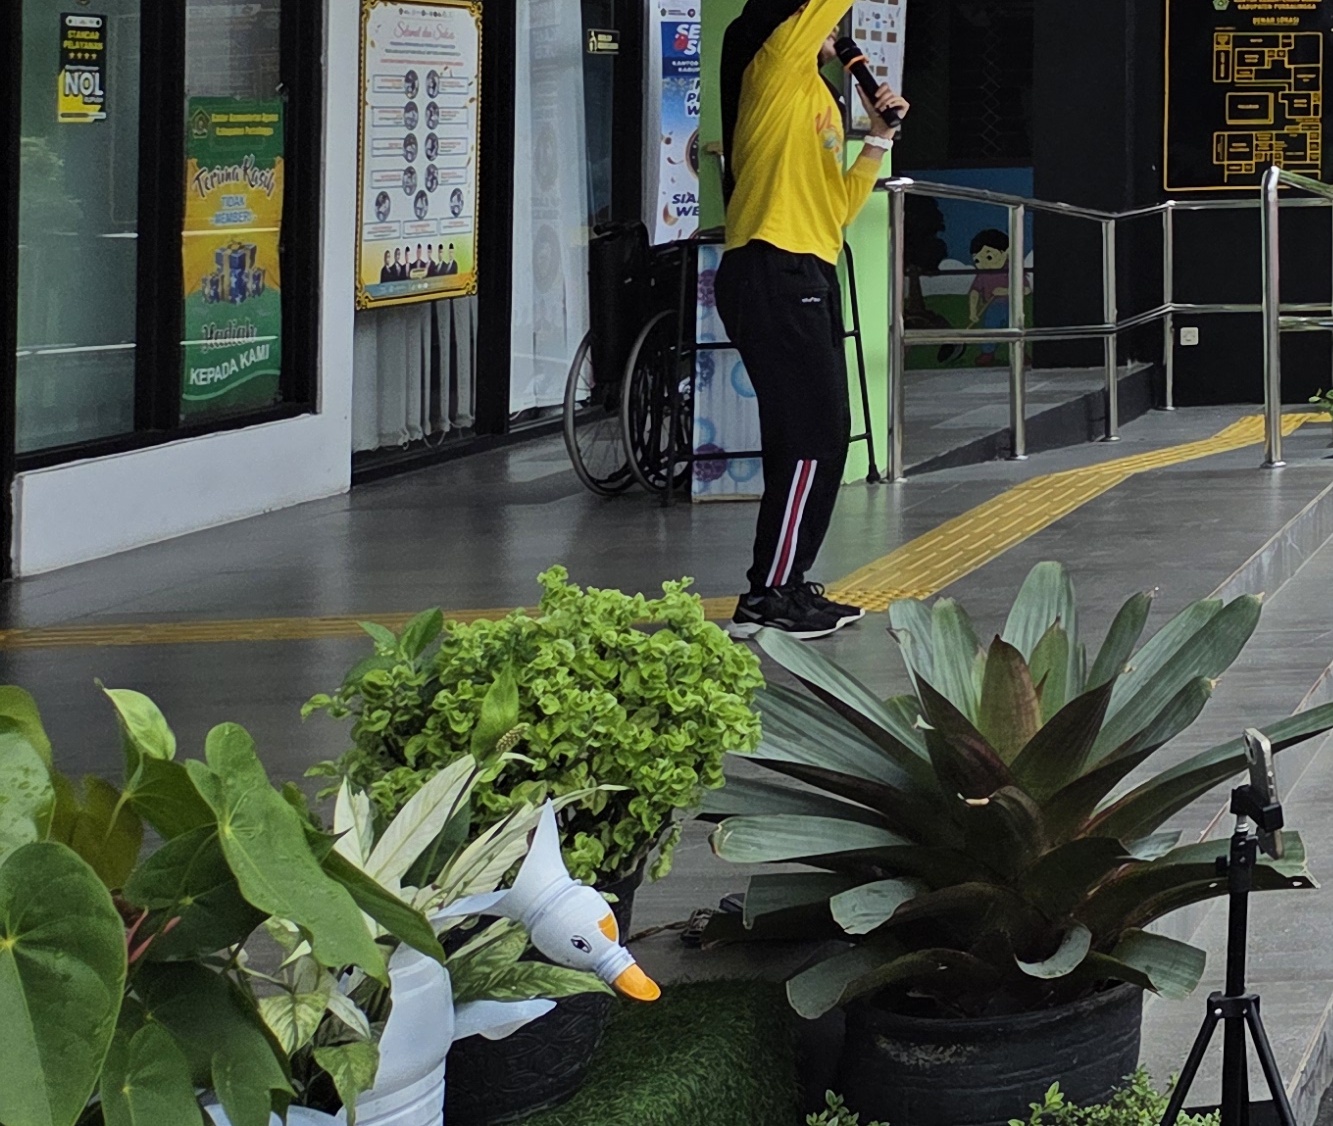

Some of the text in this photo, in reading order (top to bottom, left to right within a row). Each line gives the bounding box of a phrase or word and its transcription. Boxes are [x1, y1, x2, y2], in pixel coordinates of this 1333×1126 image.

[64, 71, 104, 96] NOL
[193, 154, 275, 199] Terima Kasih
[189, 343, 271, 386] KEPADA KAMI
